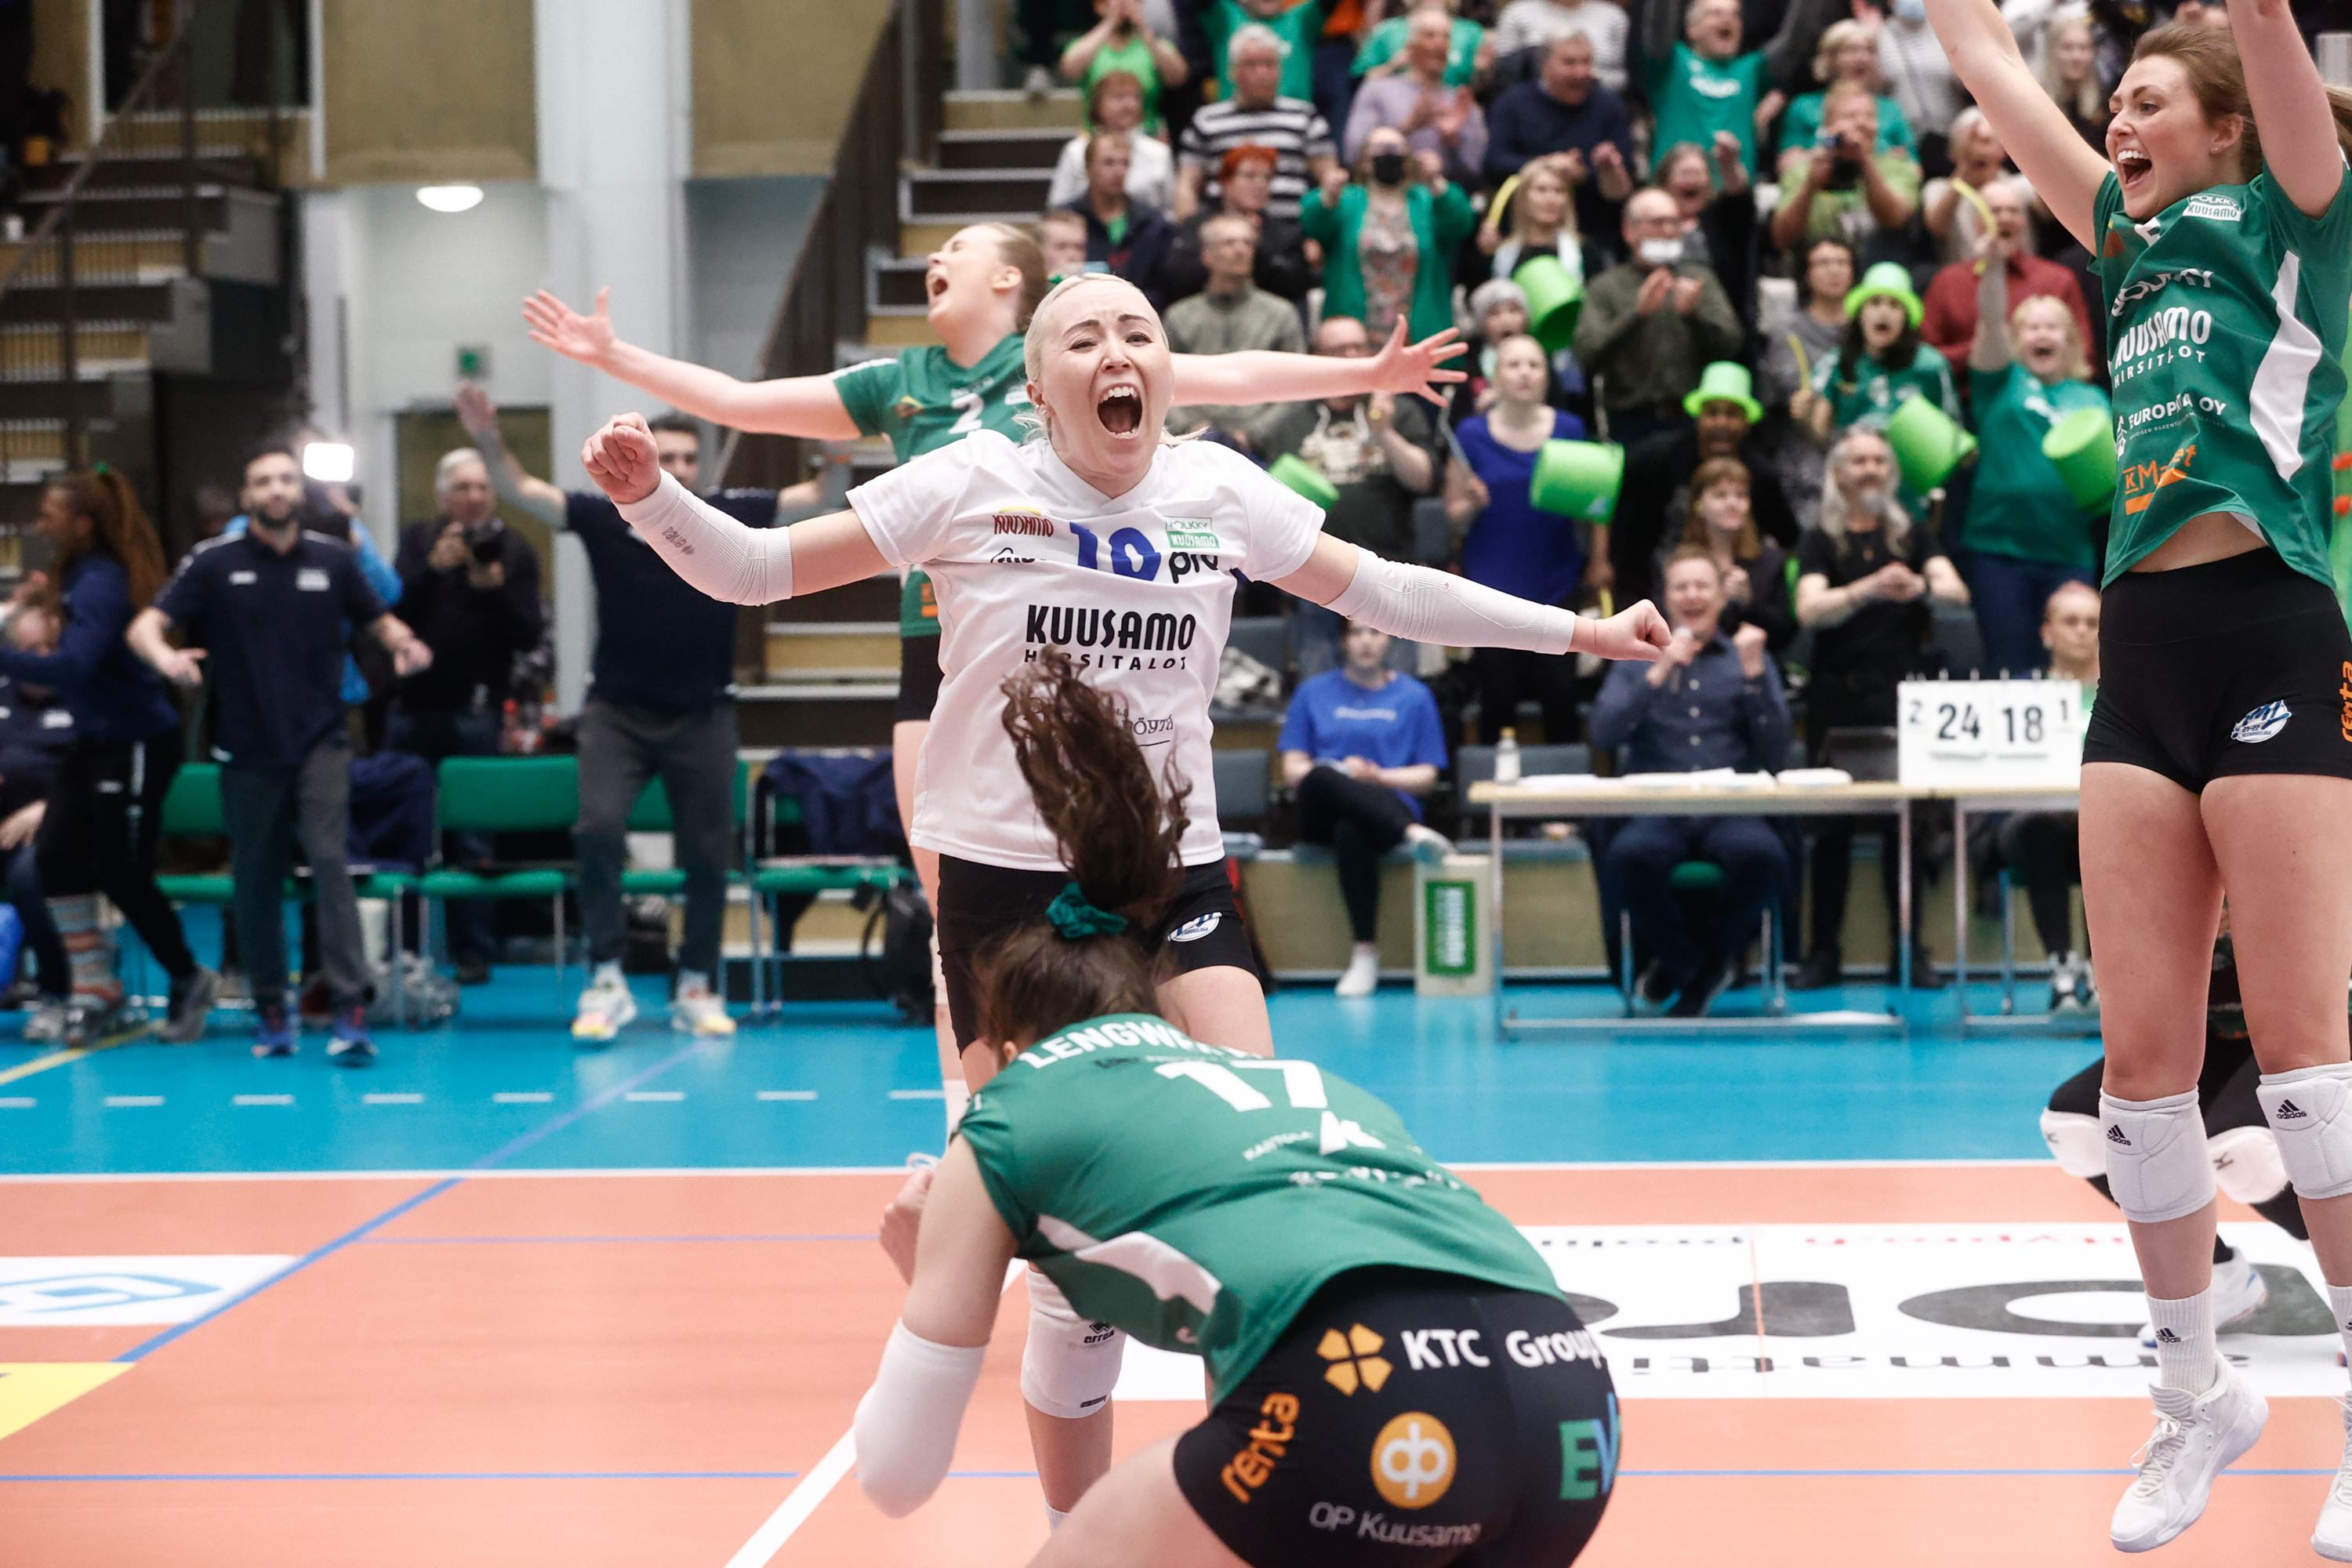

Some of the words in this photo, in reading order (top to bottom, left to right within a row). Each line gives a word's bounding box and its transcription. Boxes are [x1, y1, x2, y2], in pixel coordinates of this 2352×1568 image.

[2188, 205, 2238, 217] KUUSAMO
[2199, 397, 2227, 416] OY
[1069, 521, 1161, 582] 10
[1171, 534, 1217, 547] KUUSAMO
[1025, 604, 1196, 651] KUUSAMO
[1024, 649, 1187, 671] HSITALOT
[1910, 699, 1922, 724] 2
[1938, 702, 1980, 739] 24
[2002, 706, 2043, 743] 18
[1154, 1060, 1328, 1112] 17
[2276, 1110, 2307, 1120] adidas
[2107, 1134, 2132, 1146] adidas
[1401, 1329, 1490, 1371] KTC
[1221, 1392, 1301, 1504] renta
[1308, 1501, 1356, 1531] OP
